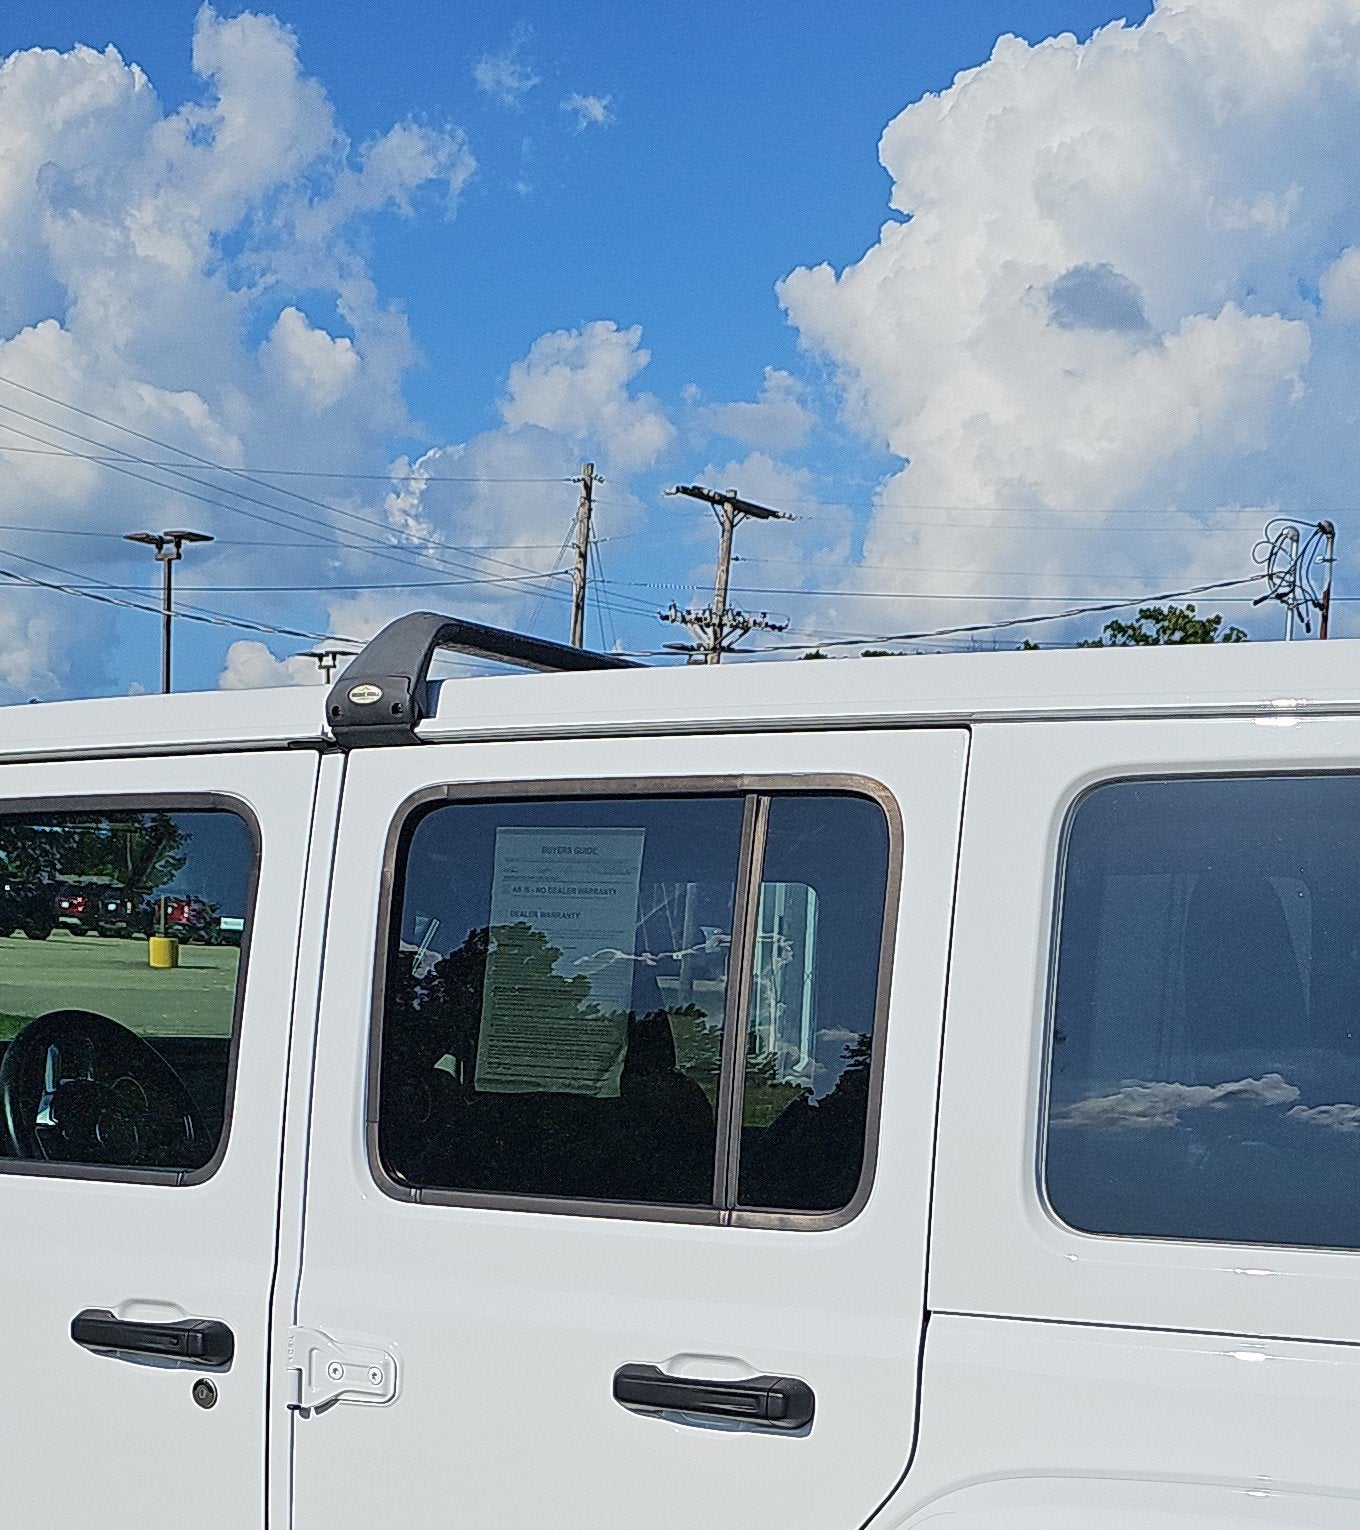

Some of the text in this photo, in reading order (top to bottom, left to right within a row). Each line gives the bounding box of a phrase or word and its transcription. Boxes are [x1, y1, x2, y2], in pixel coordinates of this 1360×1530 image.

[542, 846, 598, 855] BUYERS GUIDE
[512, 886, 524, 894] AS
[536, 886, 546, 894] NO
[548, 886, 577, 895] DEALER
[578, 887, 617, 896] WARRANTY
[510, 910, 581, 920] DEALER WARRANTY
